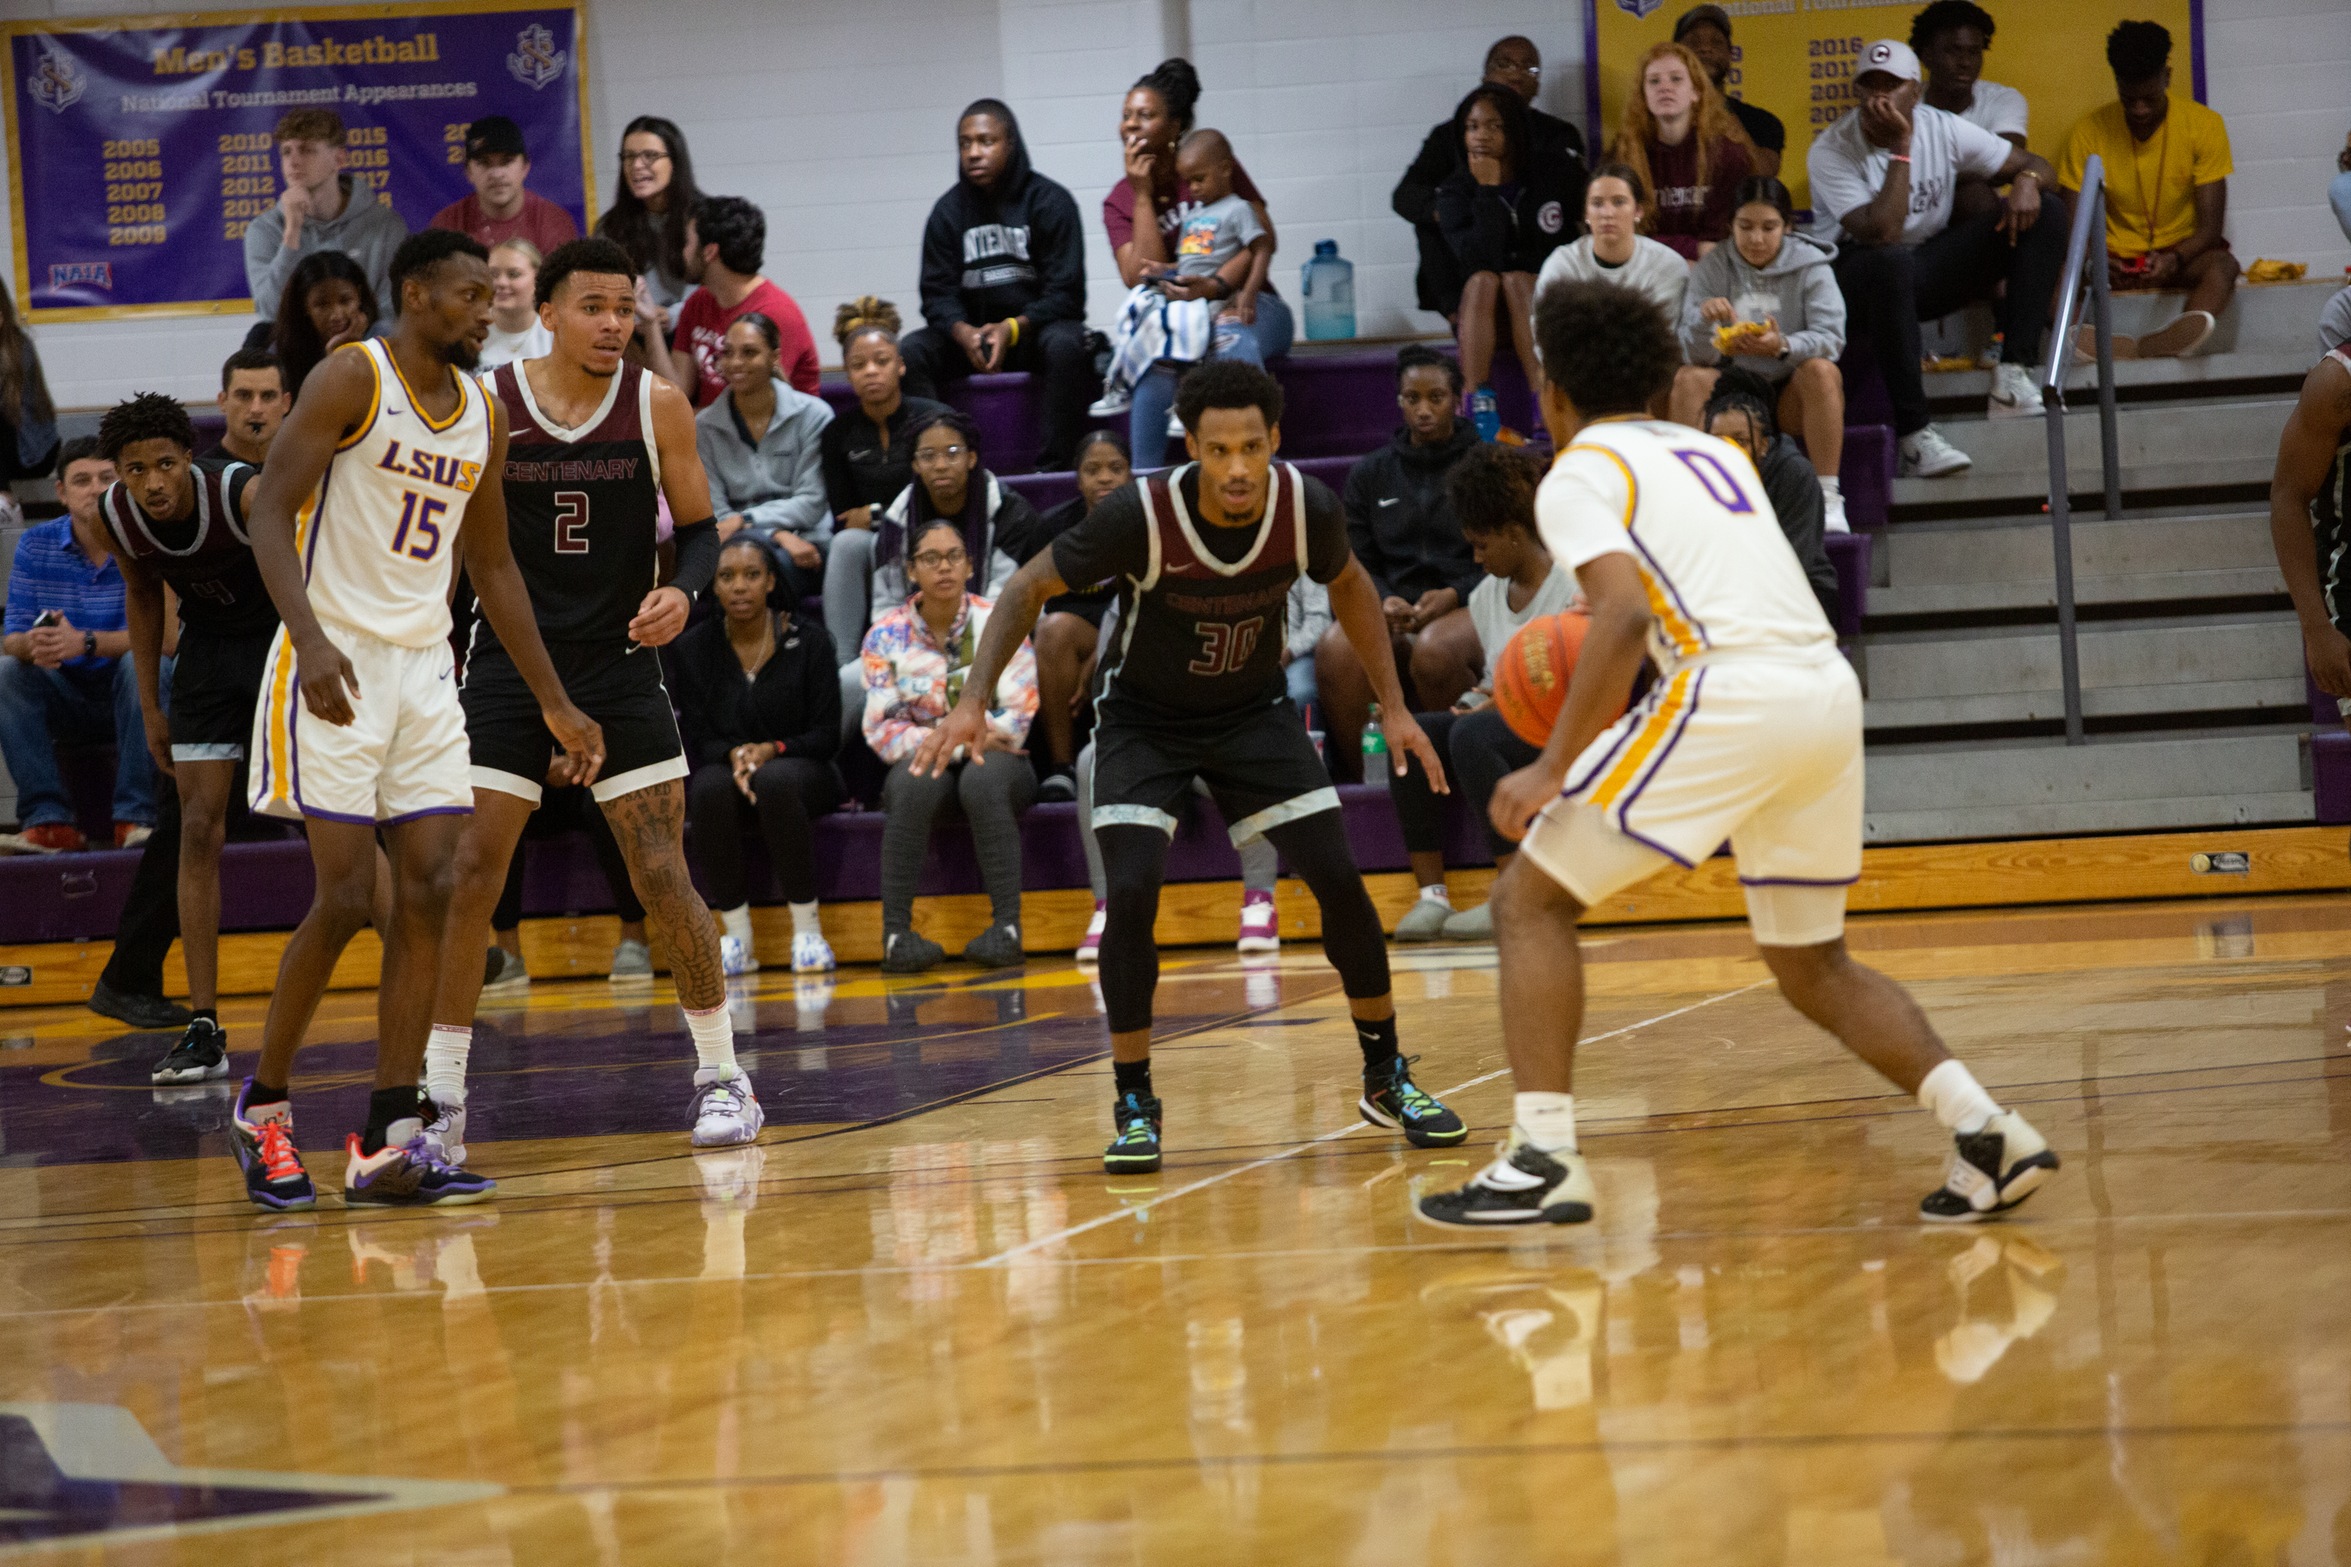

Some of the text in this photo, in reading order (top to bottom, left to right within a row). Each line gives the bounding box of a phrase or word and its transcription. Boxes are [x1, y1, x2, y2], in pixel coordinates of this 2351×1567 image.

[154, 34, 440, 75] Men's Basketball
[1809, 37, 1864, 56] 2016
[121, 81, 478, 114] National Tournament Appearances
[218, 132, 273, 153] 2010
[347, 127, 388, 147] 015
[221, 154, 273, 175] 2011
[106, 182, 164, 203] 2007
[221, 176, 276, 197] 2012
[108, 203, 166, 224] 2008
[52, 265, 107, 287] NAIA
[375, 439, 482, 493] LSUS
[503, 457, 639, 482] CENTENARY
[1668, 449, 1755, 514] 0
[390, 488, 448, 563] 15
[554, 491, 590, 554] 2
[191, 580, 236, 606] 4
[1188, 616, 1264, 677] 30
